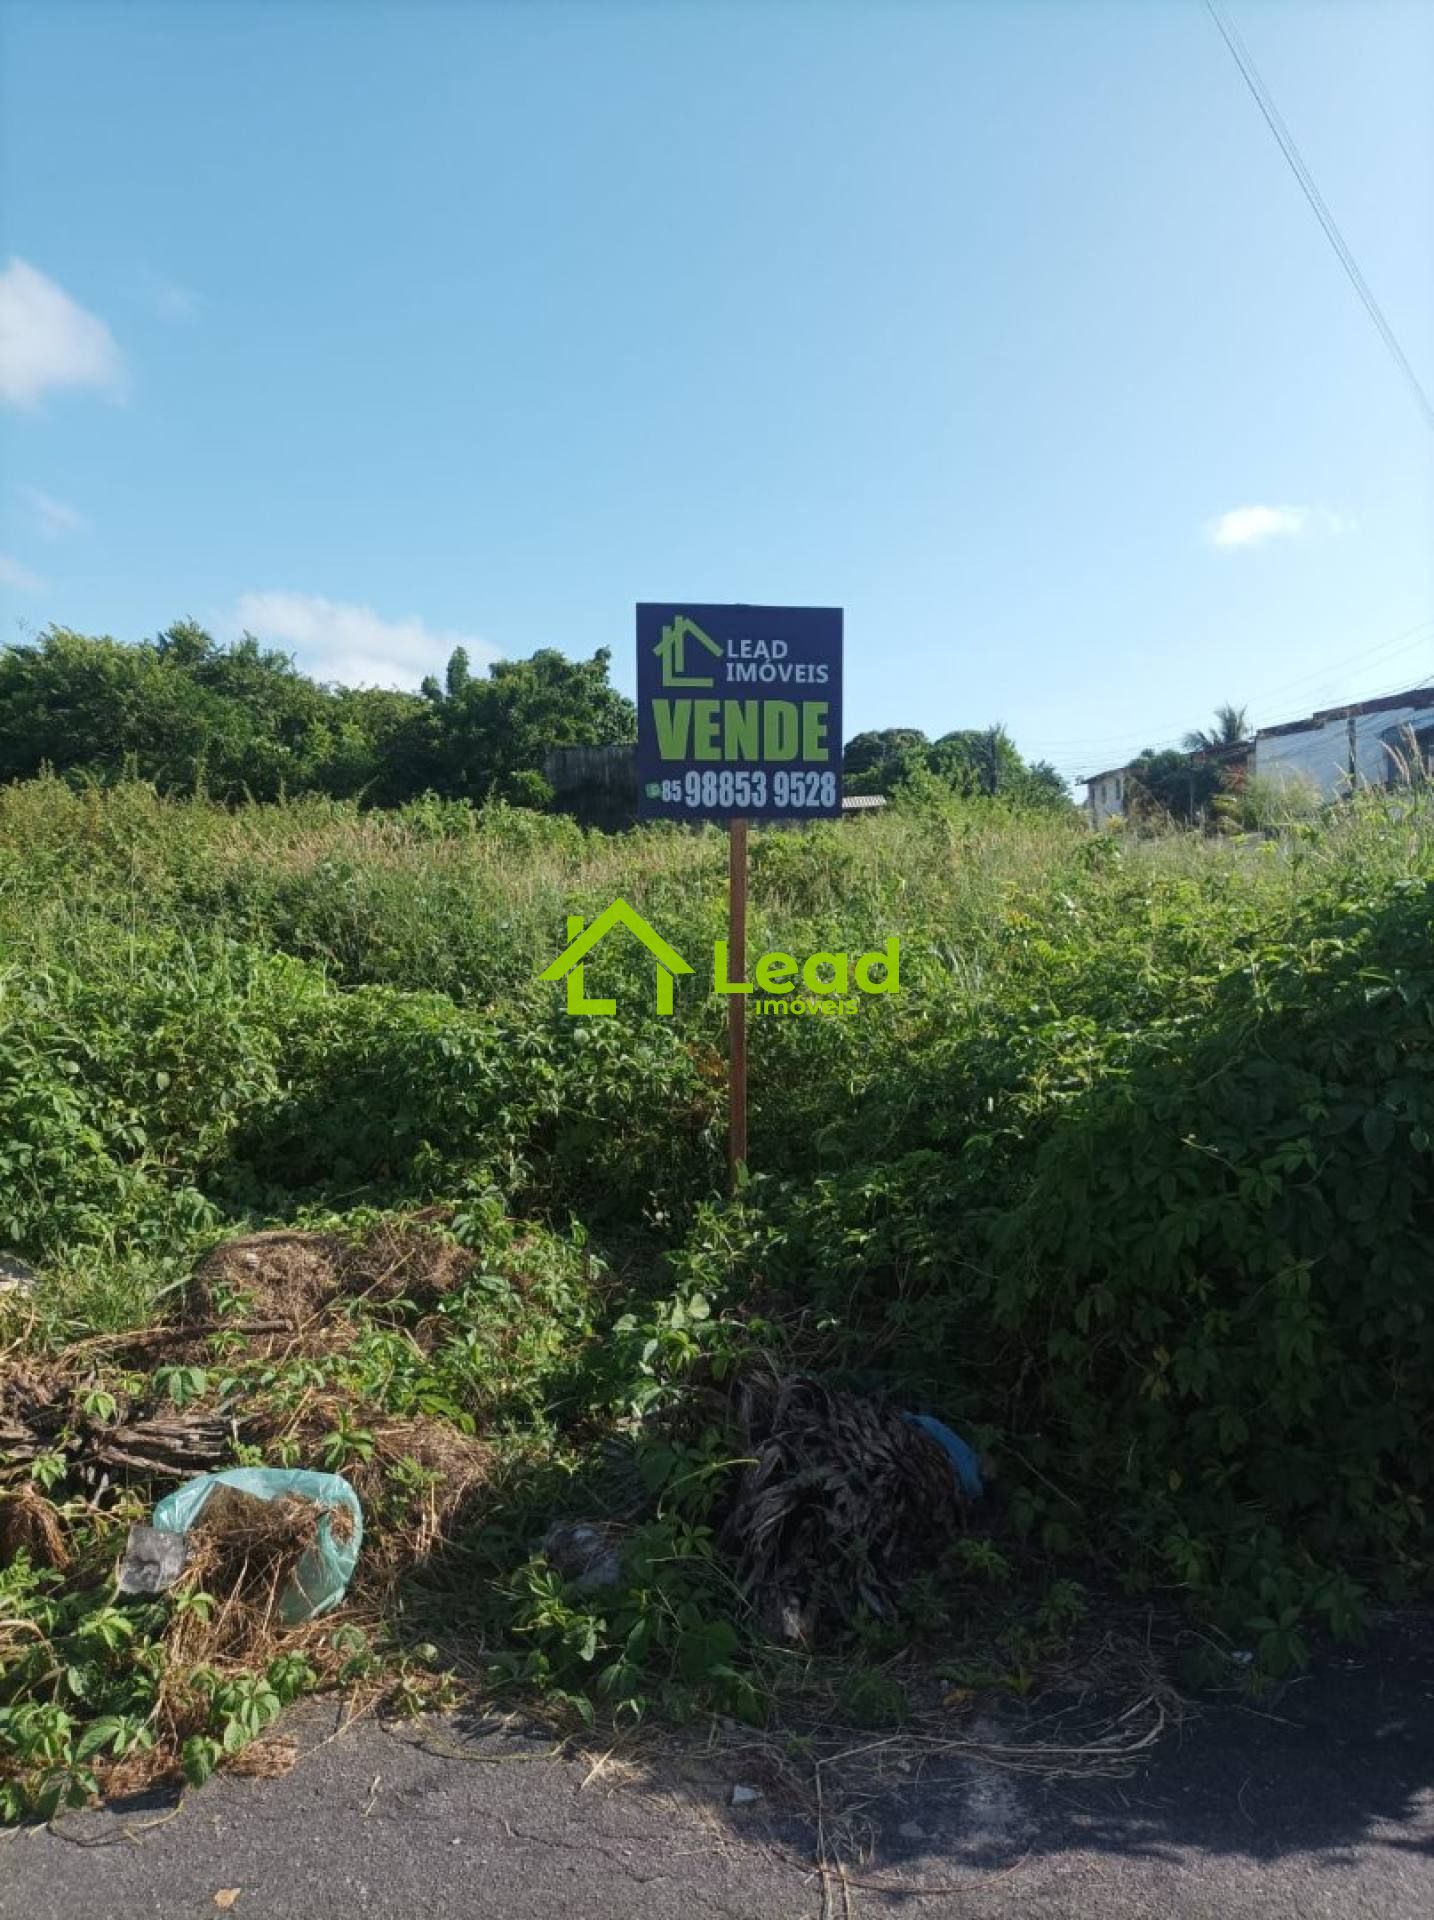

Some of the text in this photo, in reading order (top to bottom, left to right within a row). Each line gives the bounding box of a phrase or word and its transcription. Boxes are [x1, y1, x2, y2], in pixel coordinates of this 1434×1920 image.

[727, 640, 788, 659] LEAD
[726, 659, 829, 683] IMÓVEIS
[651, 698, 829, 761] VENDE
[662, 771, 836, 808] 85 98853 9528
